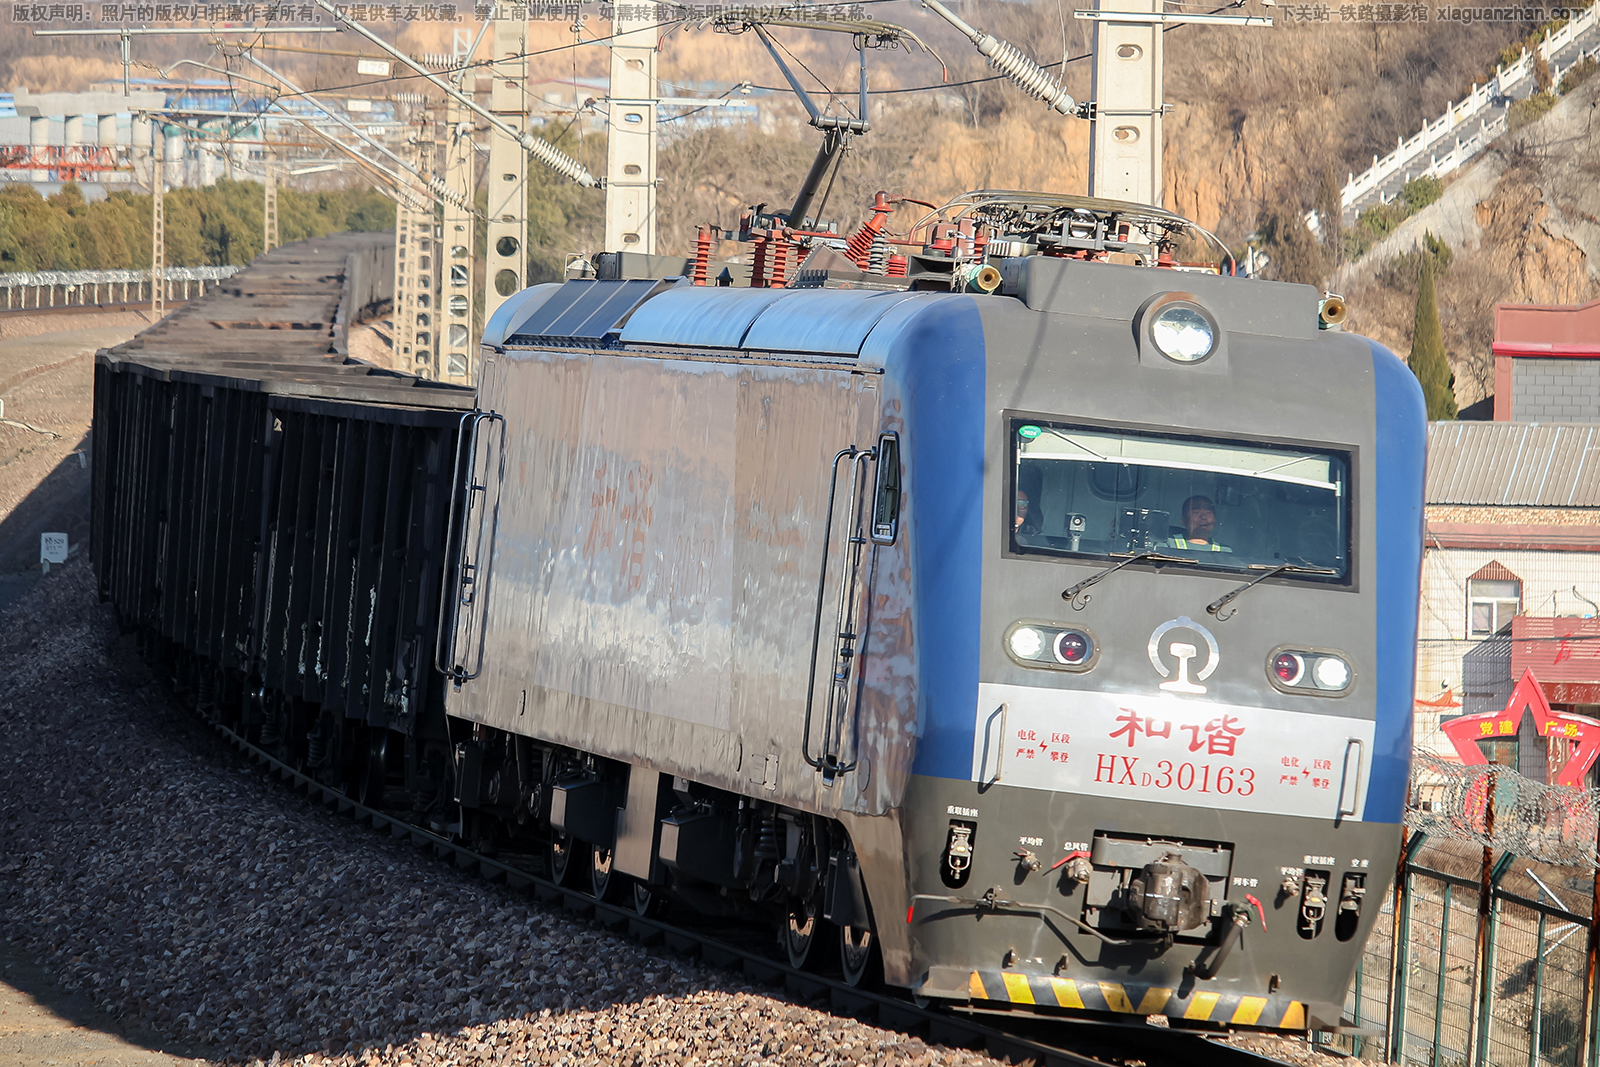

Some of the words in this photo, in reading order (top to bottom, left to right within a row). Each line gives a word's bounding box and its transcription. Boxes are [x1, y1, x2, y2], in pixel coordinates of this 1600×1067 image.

[1017, 729, 1036, 741] 电化
[1051, 732, 1071, 744] 区段
[1108, 707, 1246, 757] 和谐
[1015, 747, 1035, 759] 严禁
[1280, 756, 1300, 768] 电化
[1313, 758, 1332, 770] 区段
[1094, 753, 1256, 797] HXD30163
[1279, 774, 1298, 786] 严禁
